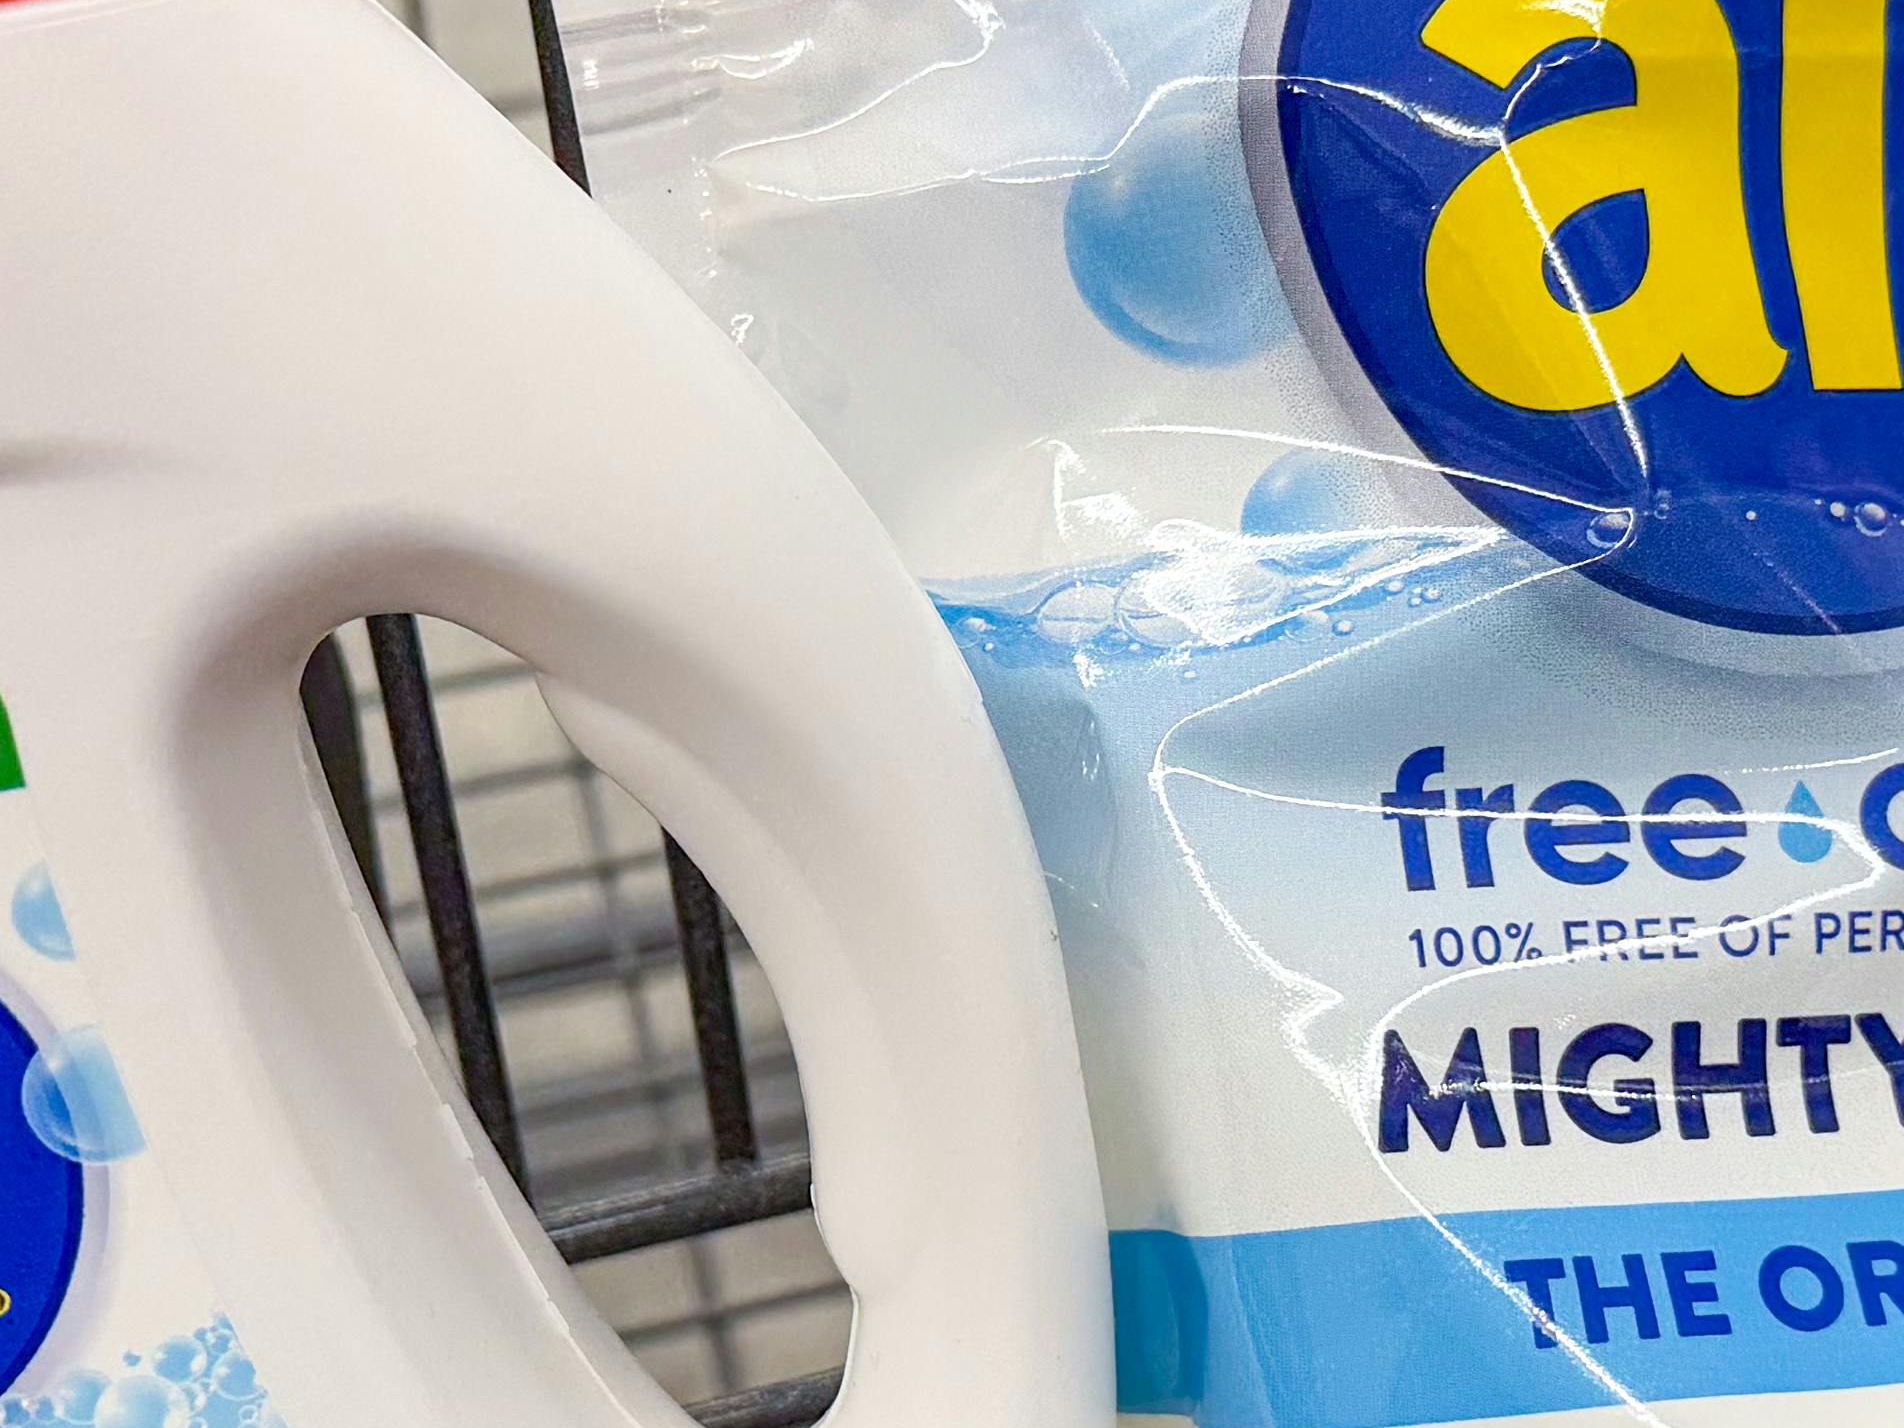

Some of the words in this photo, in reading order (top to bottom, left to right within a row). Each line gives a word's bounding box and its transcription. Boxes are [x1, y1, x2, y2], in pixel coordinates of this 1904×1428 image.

[1380, 745, 1748, 892] free
[1408, 920, 1543, 969] 100%
[1561, 917, 1699, 965] FREE
[1718, 912, 1793, 959] OF
[1503, 1248, 1735, 1352] THE
